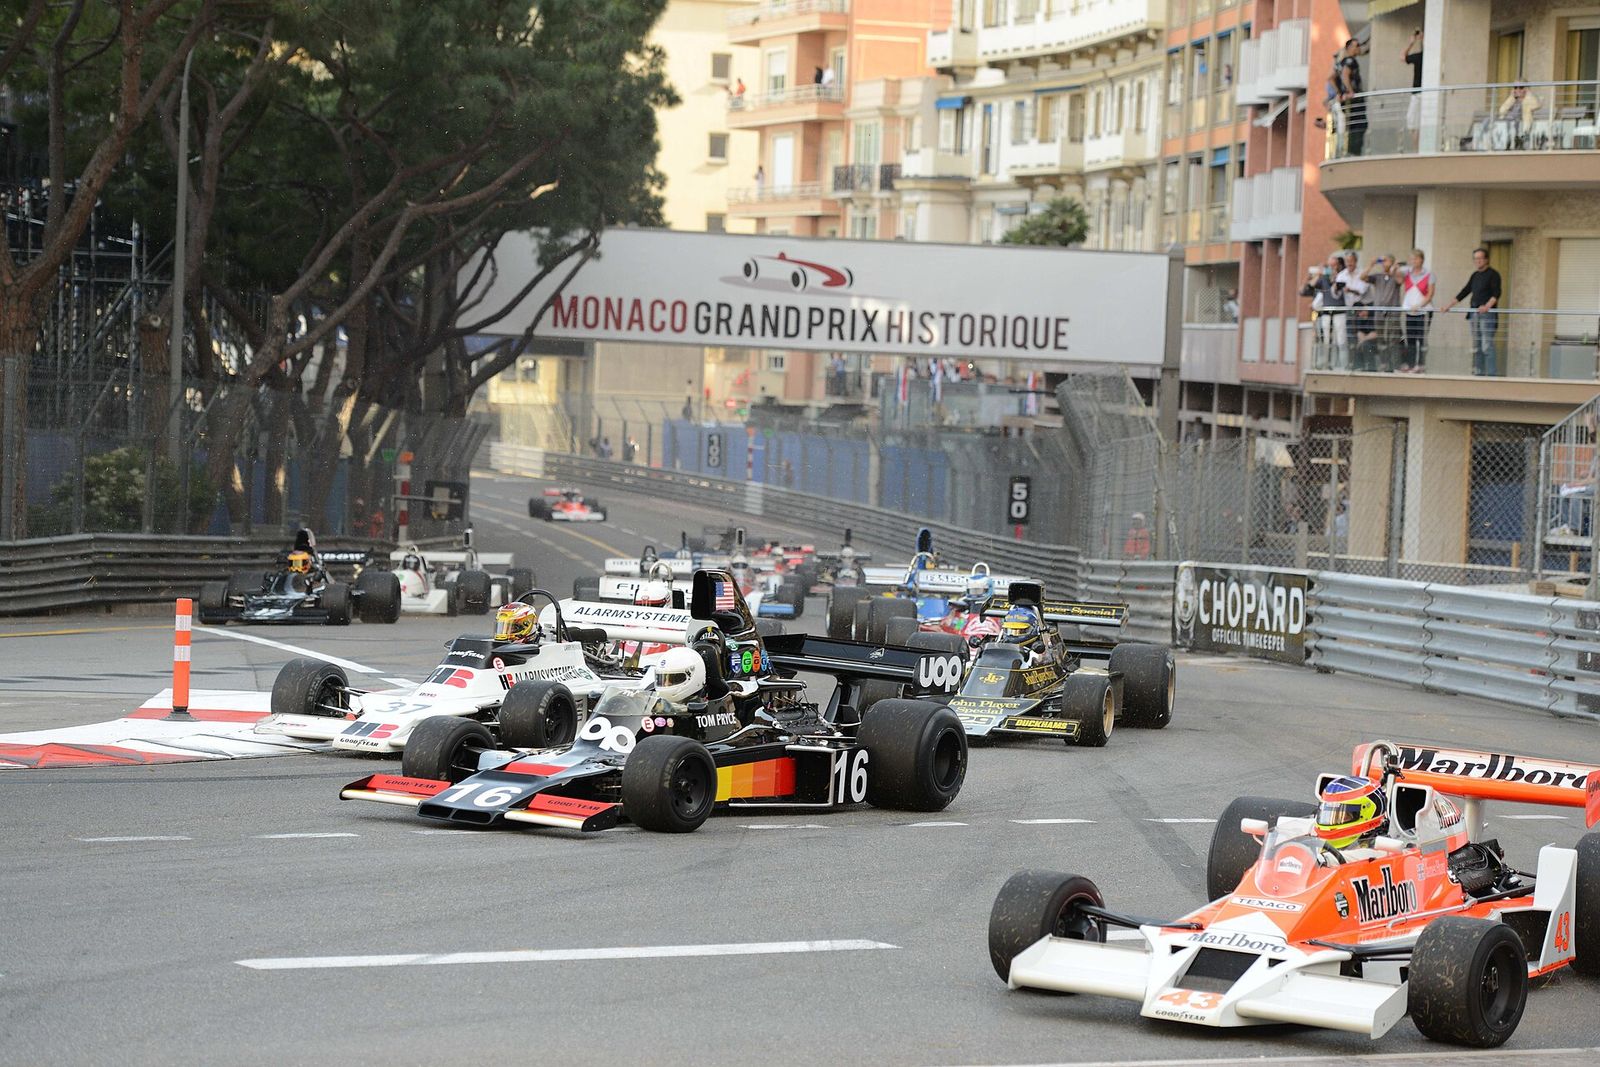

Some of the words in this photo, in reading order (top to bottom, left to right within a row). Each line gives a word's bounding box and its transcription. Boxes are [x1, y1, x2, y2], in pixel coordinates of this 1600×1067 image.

[553, 294, 687, 334] MONACO
[694, 301, 801, 339] GRAND
[807, 306, 879, 342] PRIX
[886, 310, 1070, 351] HISTORIQUE
[1011, 482, 1028, 519] 50
[574, 606, 692, 624] ALARMSYSTEME
[1199, 578, 1304, 635] CHOPARD
[1211, 627, 1241, 646] OFFICIAL
[1242, 631, 1286, 652] TIMEKEEPER
[375, 701, 432, 715] 37
[956, 706, 1004, 715] Special
[979, 700, 1021, 710] Player
[695, 715, 715, 728] TOM
[716, 712, 737, 726] PRYCE
[1015, 719, 1068, 730] DUCKHAMS
[834, 749, 869, 804] 16
[443, 782, 523, 807] 16
[1239, 898, 1297, 911] TEXACO
[1352, 866, 1417, 923] Marlboro
[1187, 931, 1287, 954] Marlboro
[1555, 911, 1570, 953] 43
[1158, 989, 1225, 1010] 43
